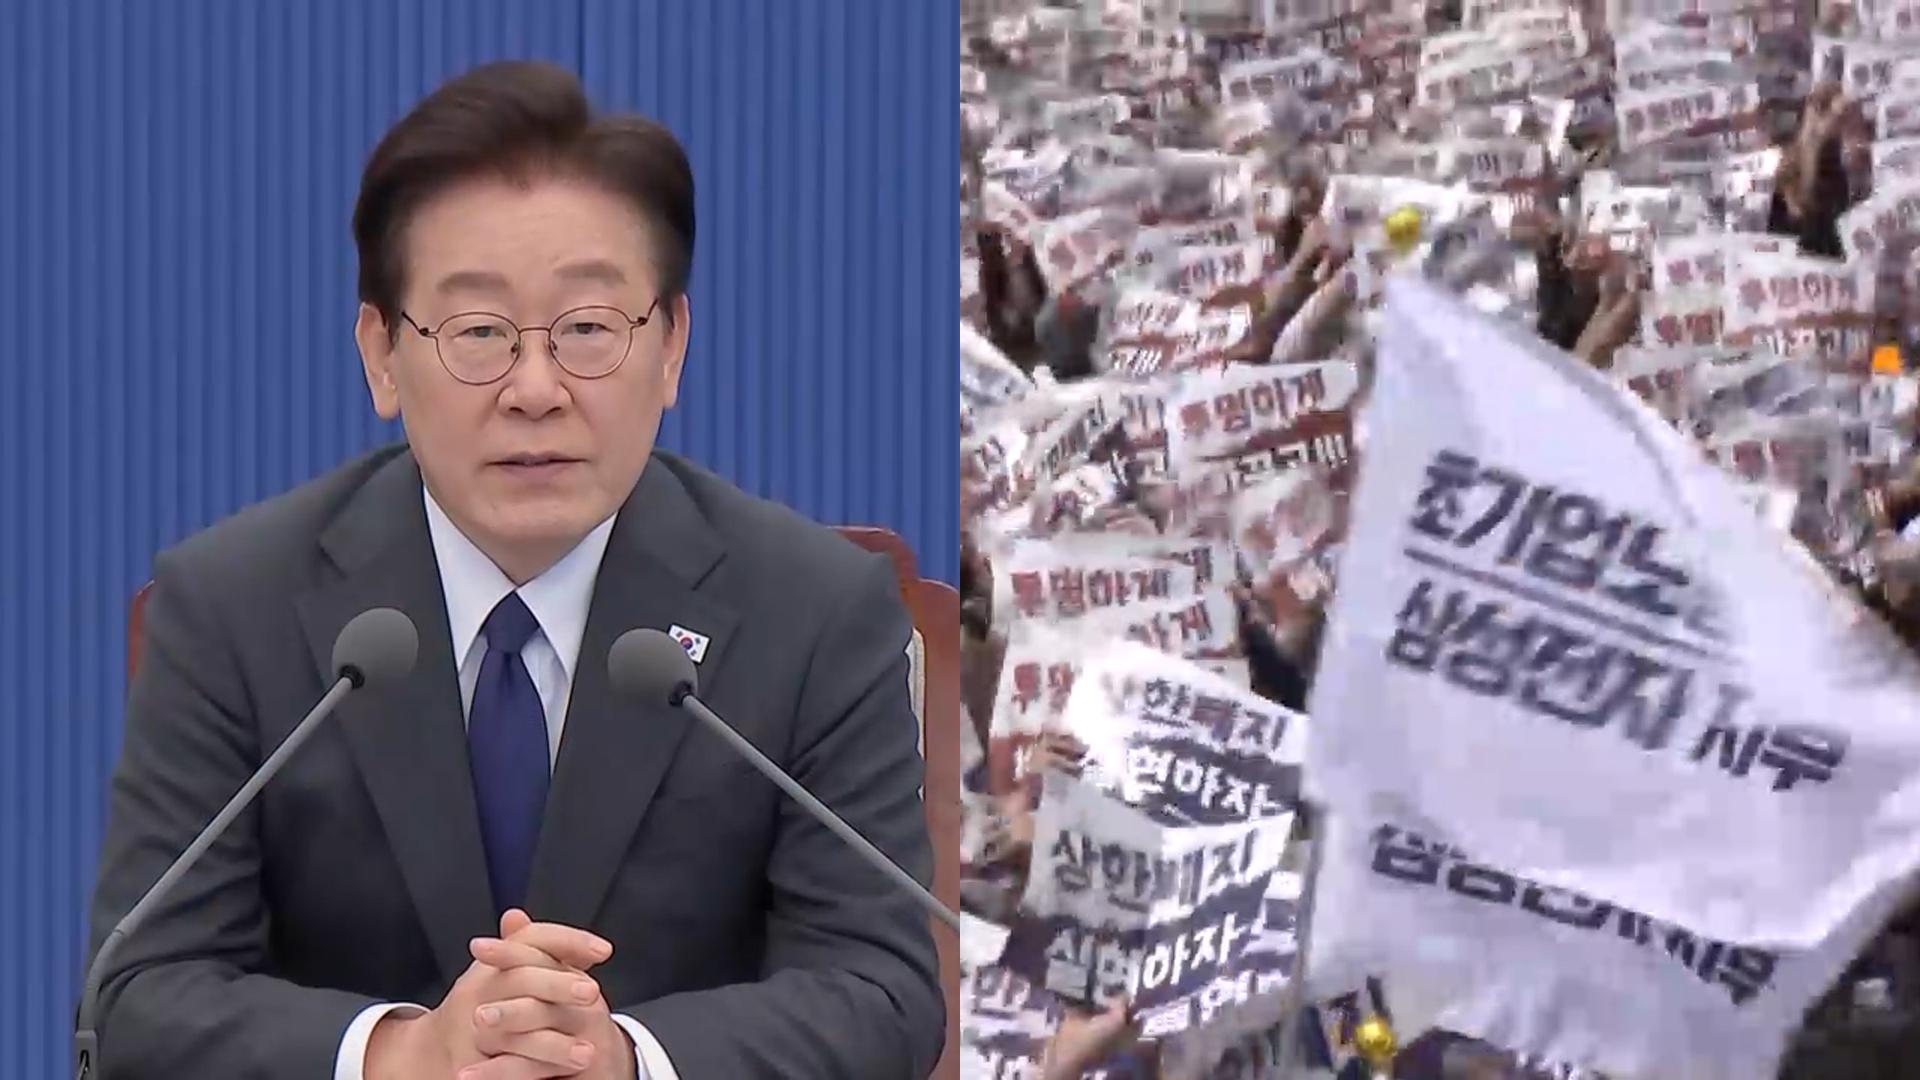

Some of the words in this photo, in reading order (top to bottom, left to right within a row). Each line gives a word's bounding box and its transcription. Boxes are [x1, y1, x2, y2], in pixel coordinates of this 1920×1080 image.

[1180, 367, 1326, 439] 투명하게
[1010, 566, 1170, 617] 투명하게
[1386, 579, 1695, 752] 삼성전자
[1051, 826, 1258, 908] 상한폐지
